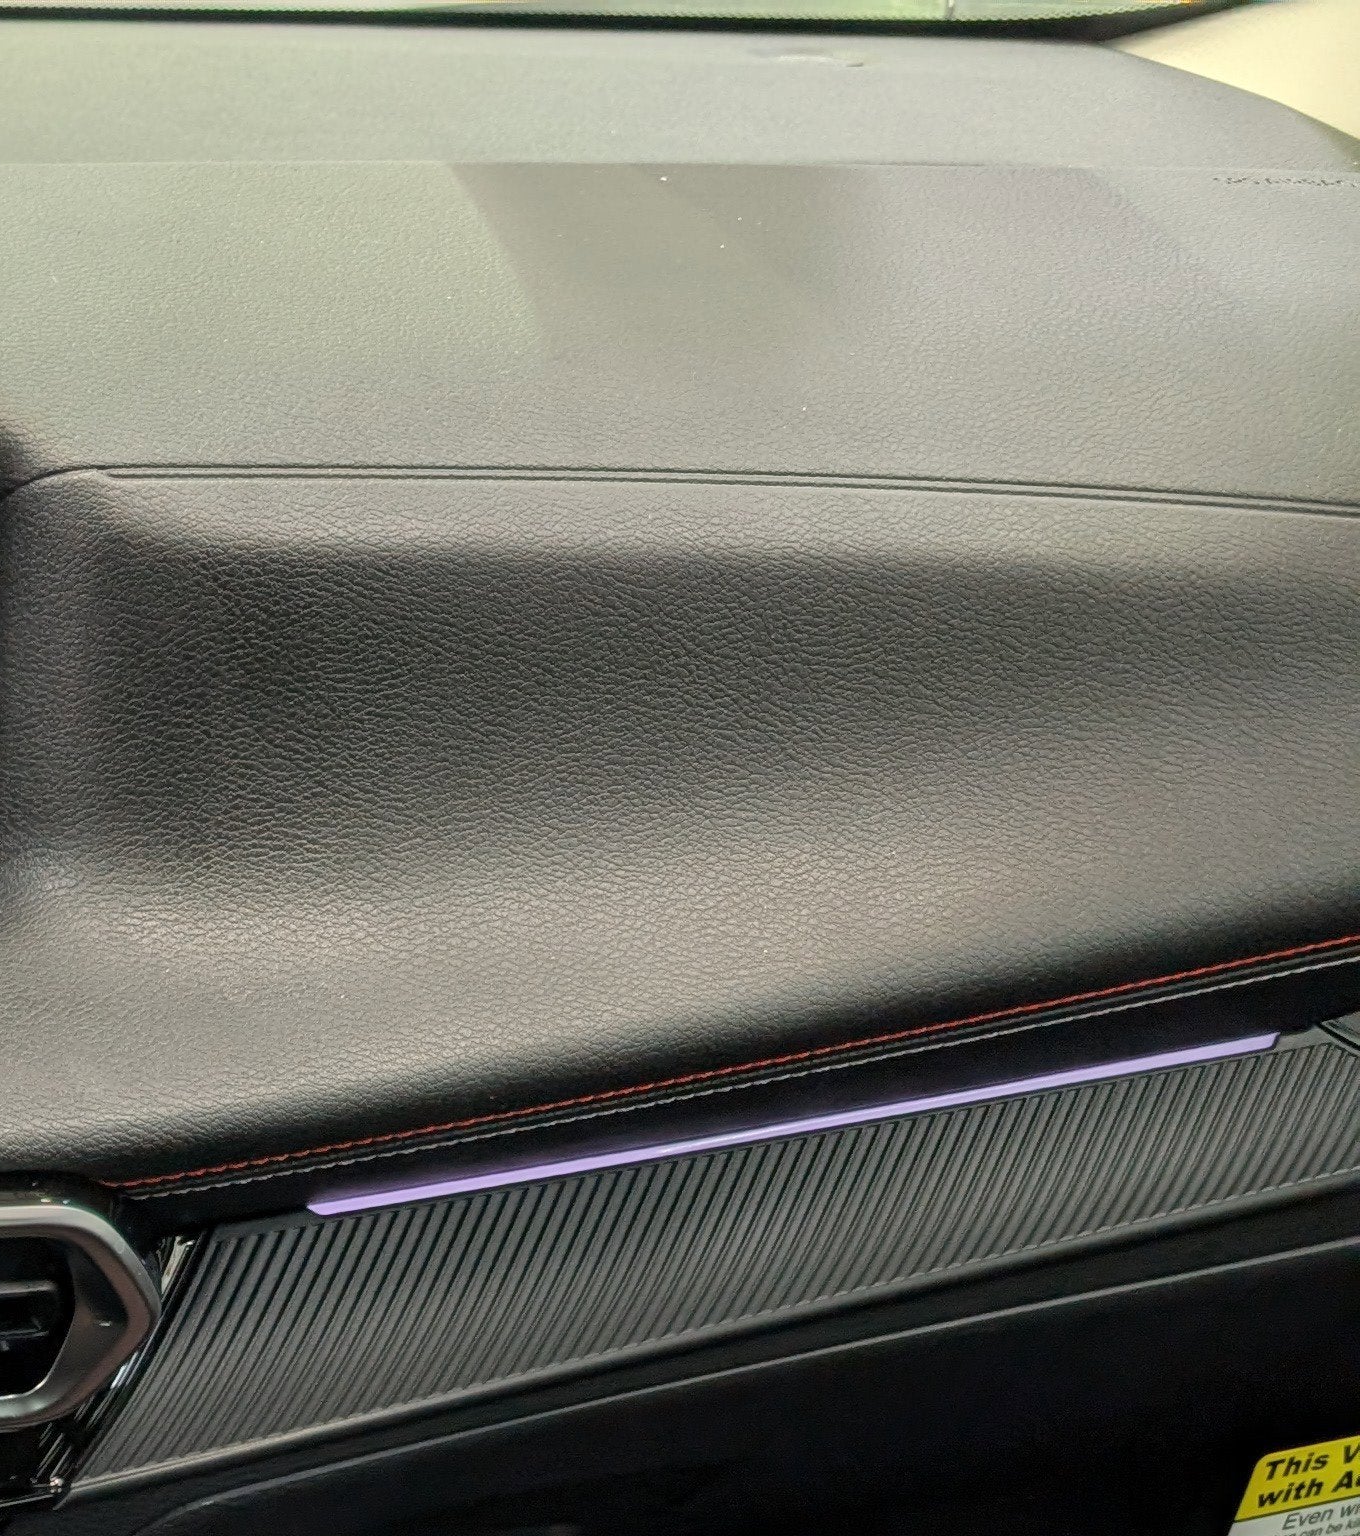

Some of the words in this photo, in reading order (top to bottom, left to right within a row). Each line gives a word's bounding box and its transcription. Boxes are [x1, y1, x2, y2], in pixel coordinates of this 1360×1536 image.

[1266, 1452, 1330, 1480] This
[1258, 1478, 1324, 1508] with
[1282, 1509, 1334, 1530] Even
[1325, 1523, 1343, 1535] be
